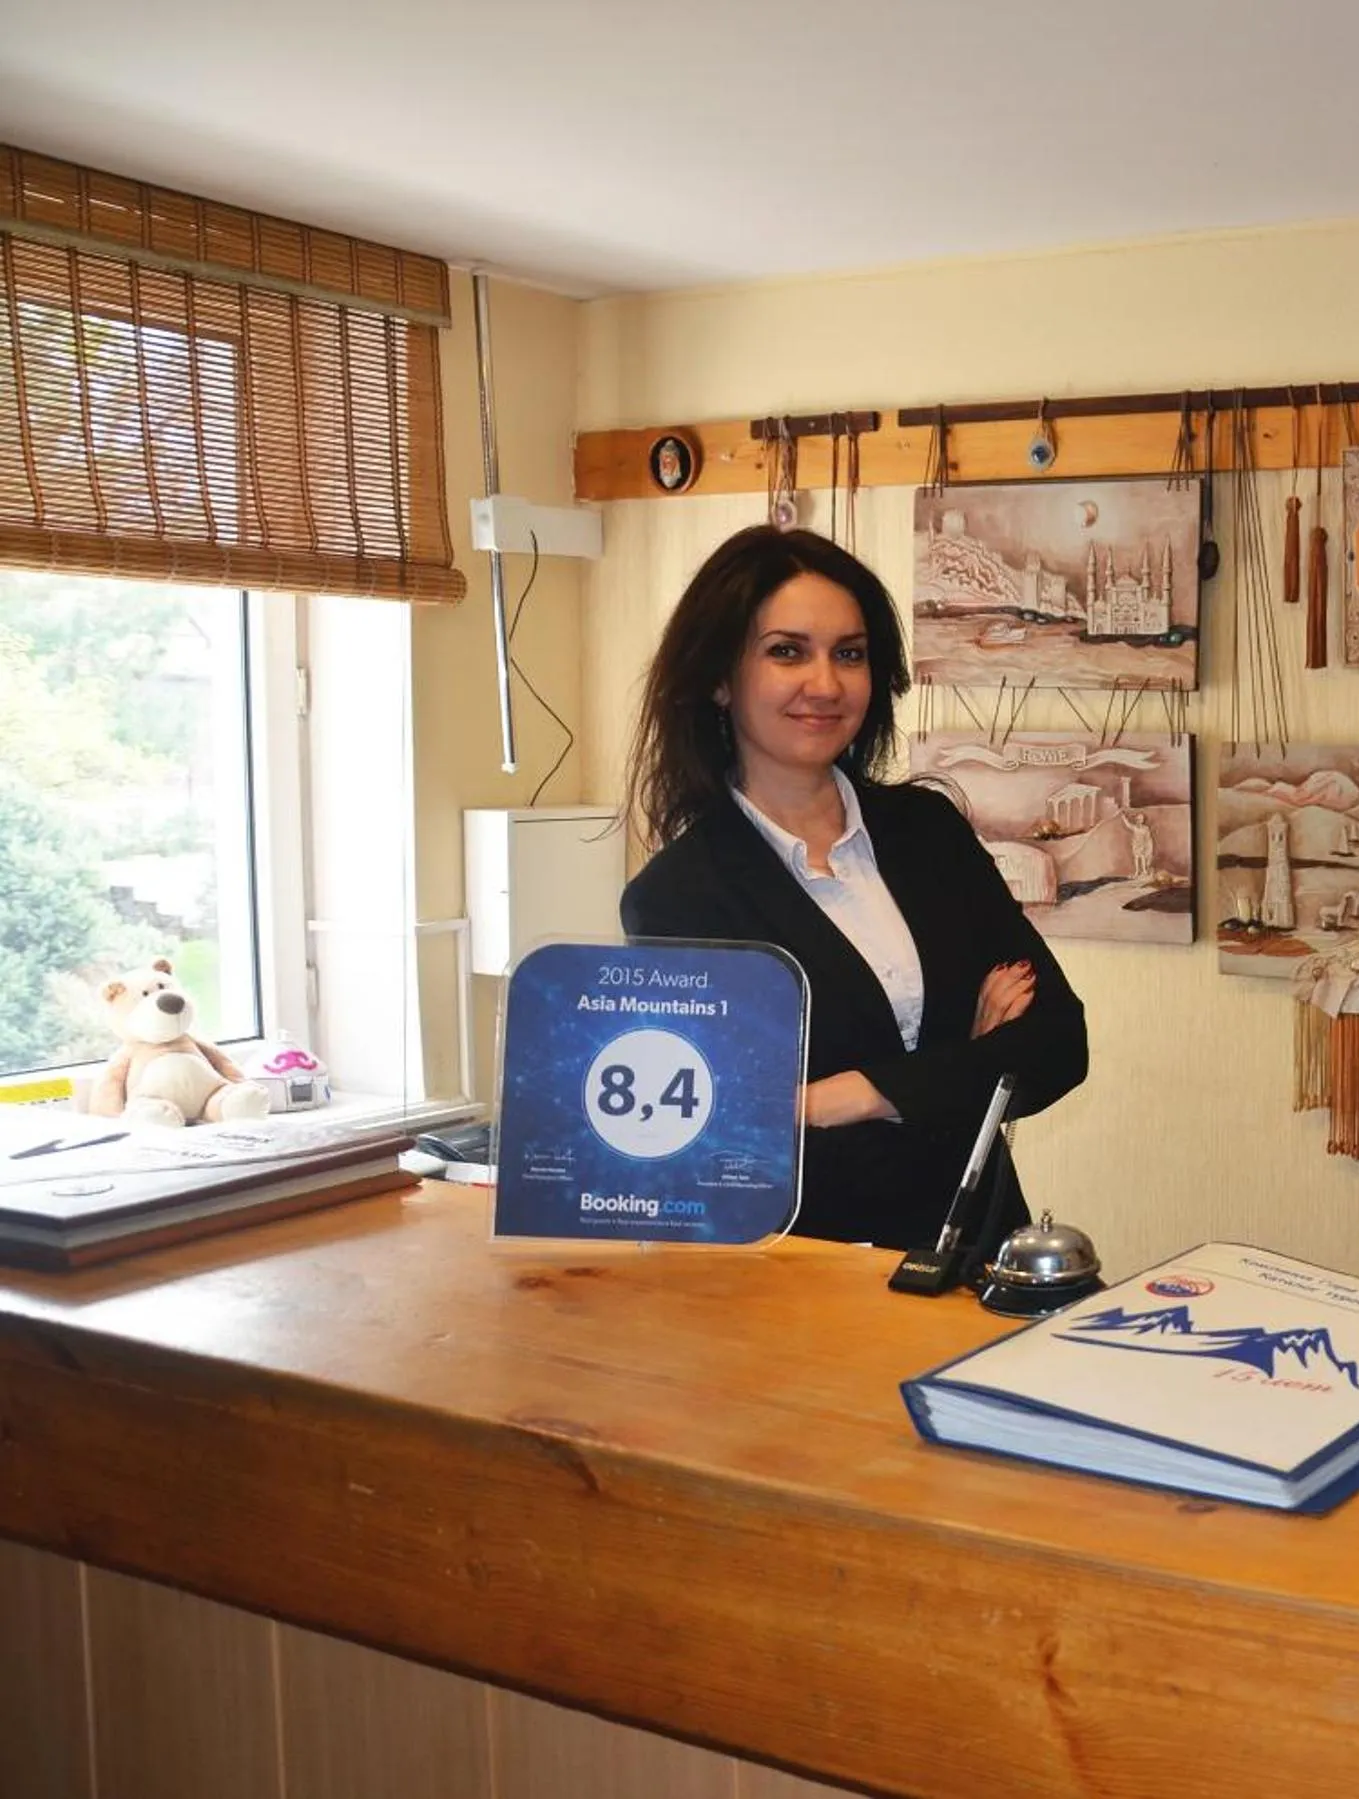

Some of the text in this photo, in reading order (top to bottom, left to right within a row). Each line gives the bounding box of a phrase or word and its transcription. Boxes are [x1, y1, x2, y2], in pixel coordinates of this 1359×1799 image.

[598, 966, 709, 988] 2015 Award
[577, 994, 729, 1016] Asia Mountains 1
[597, 1065, 700, 1123] 8,4
[580, 1192, 706, 1218] Booking.com
